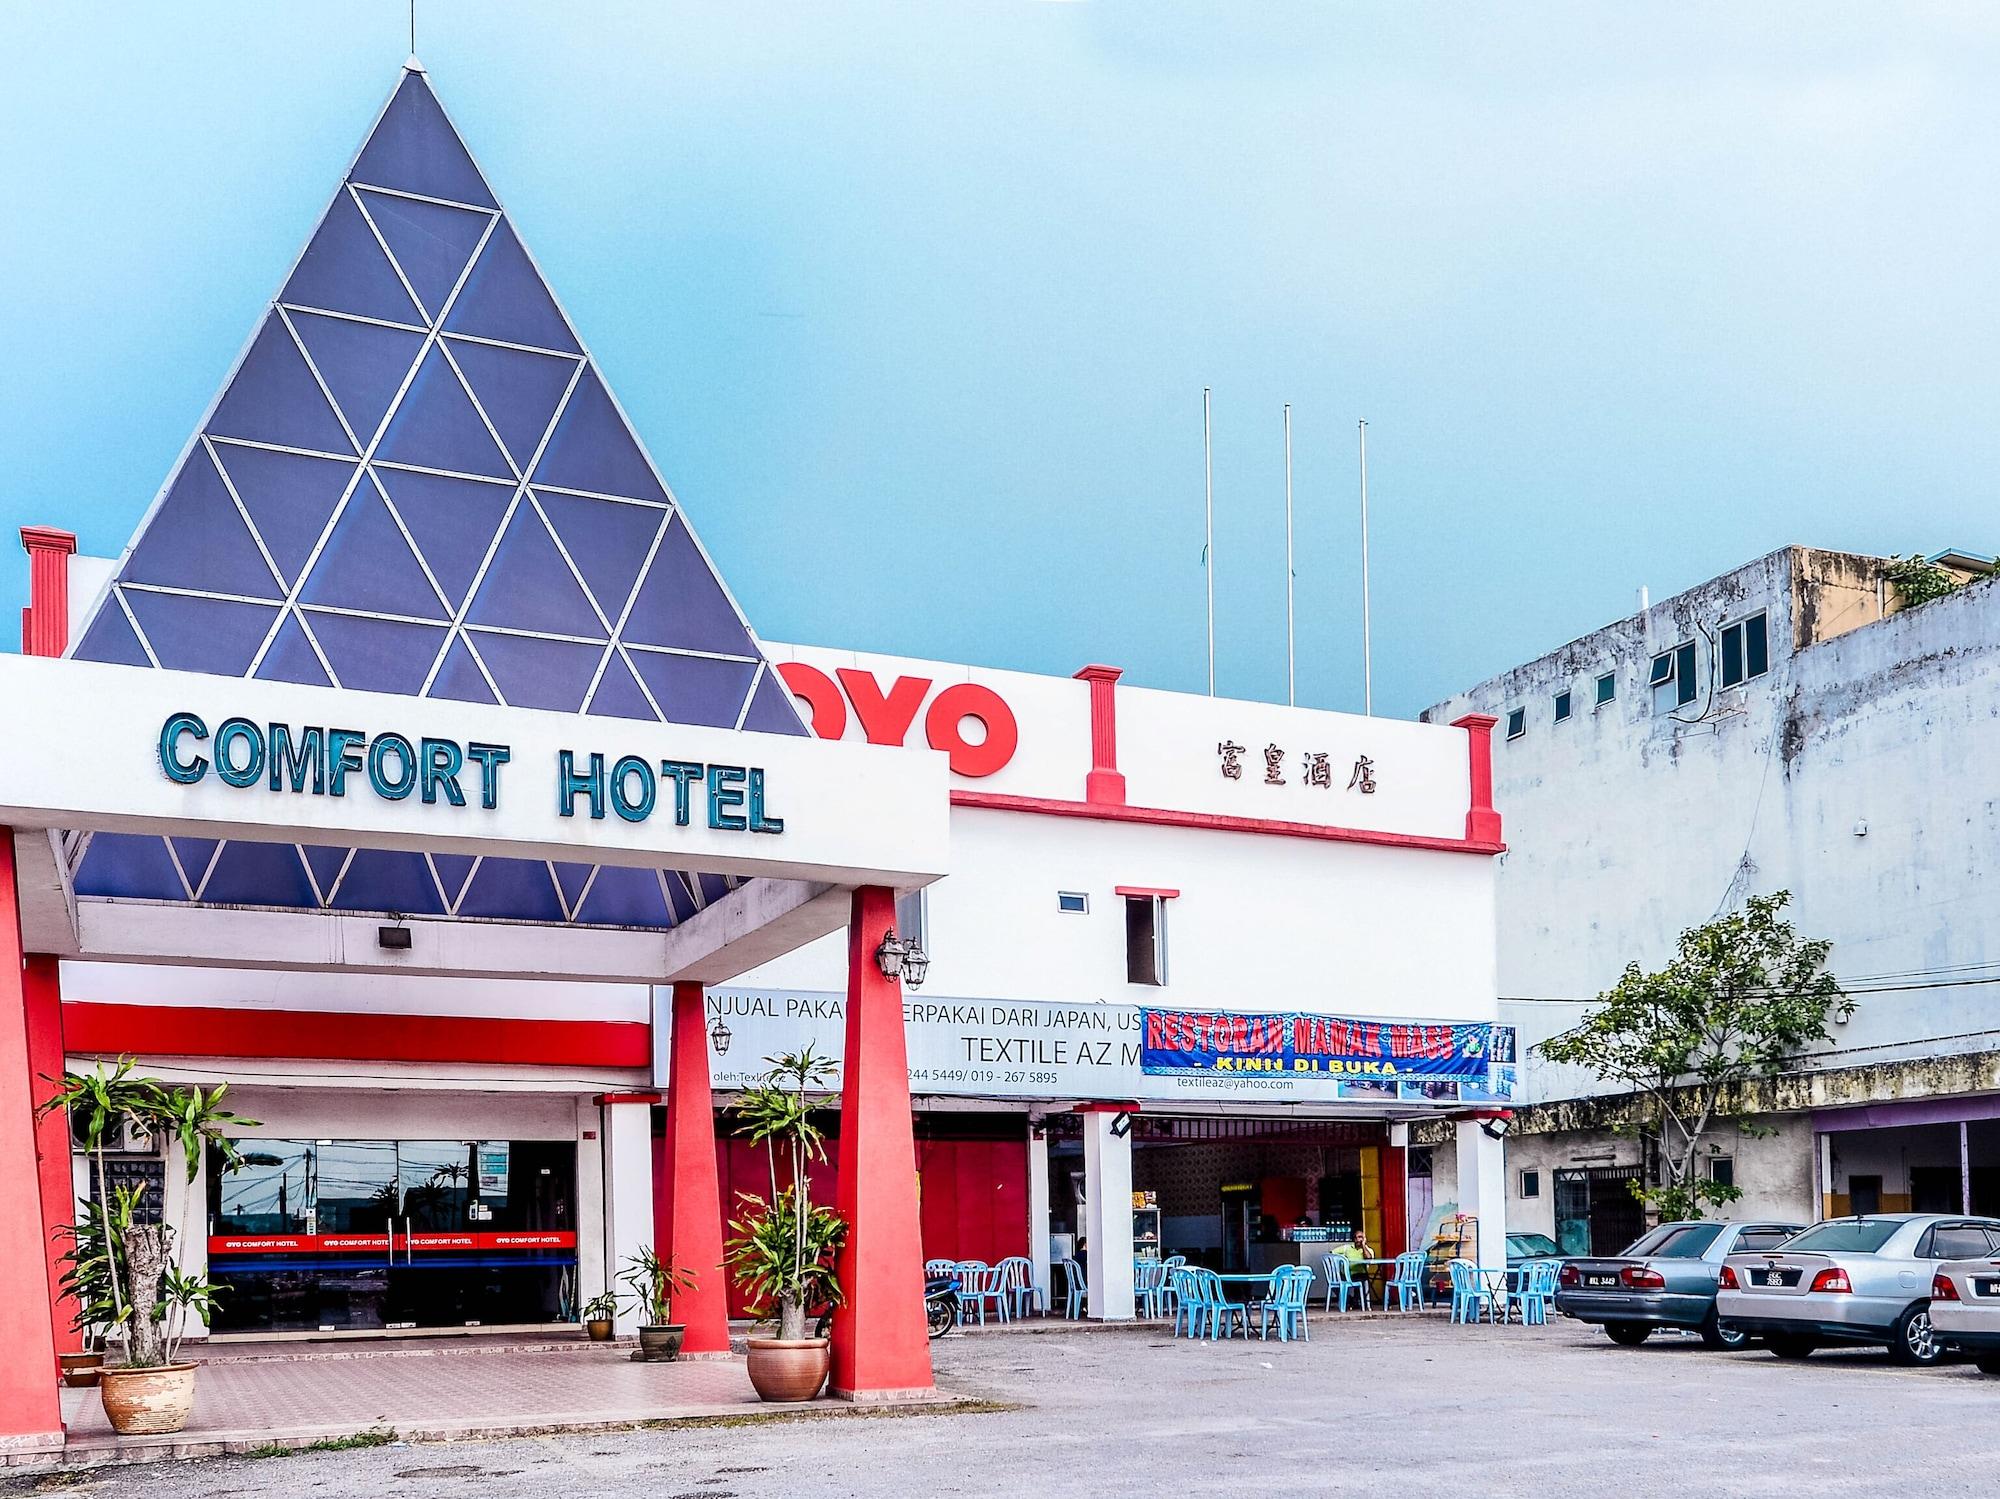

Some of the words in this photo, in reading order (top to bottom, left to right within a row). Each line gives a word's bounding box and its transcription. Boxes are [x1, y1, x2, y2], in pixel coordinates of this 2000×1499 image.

[159, 711, 511, 809] COMFORT
[558, 749, 785, 833] HOTEL
[1217, 740, 1377, 794] 富皇酒店
[992, 1007, 1038, 1027] DARI
[1044, 1010, 1111, 1032] JAPAN,
[1147, 1013, 1284, 1054] RESTORAN
[961, 1037, 1067, 1065] TEXTILE
[1076, 1042, 1112, 1066] AZ
[932, 1068, 968, 1082] 5449/
[971, 1070, 994, 1082] 019
[1005, 1071, 1026, 1083] 267
[1029, 1072, 1058, 1084] 5895
[1294, 1059, 1319, 1072] DI
[1328, 1060, 1398, 1075] BUKA
[1177, 1077, 1294, 1090] textileaz@yahoo.com
